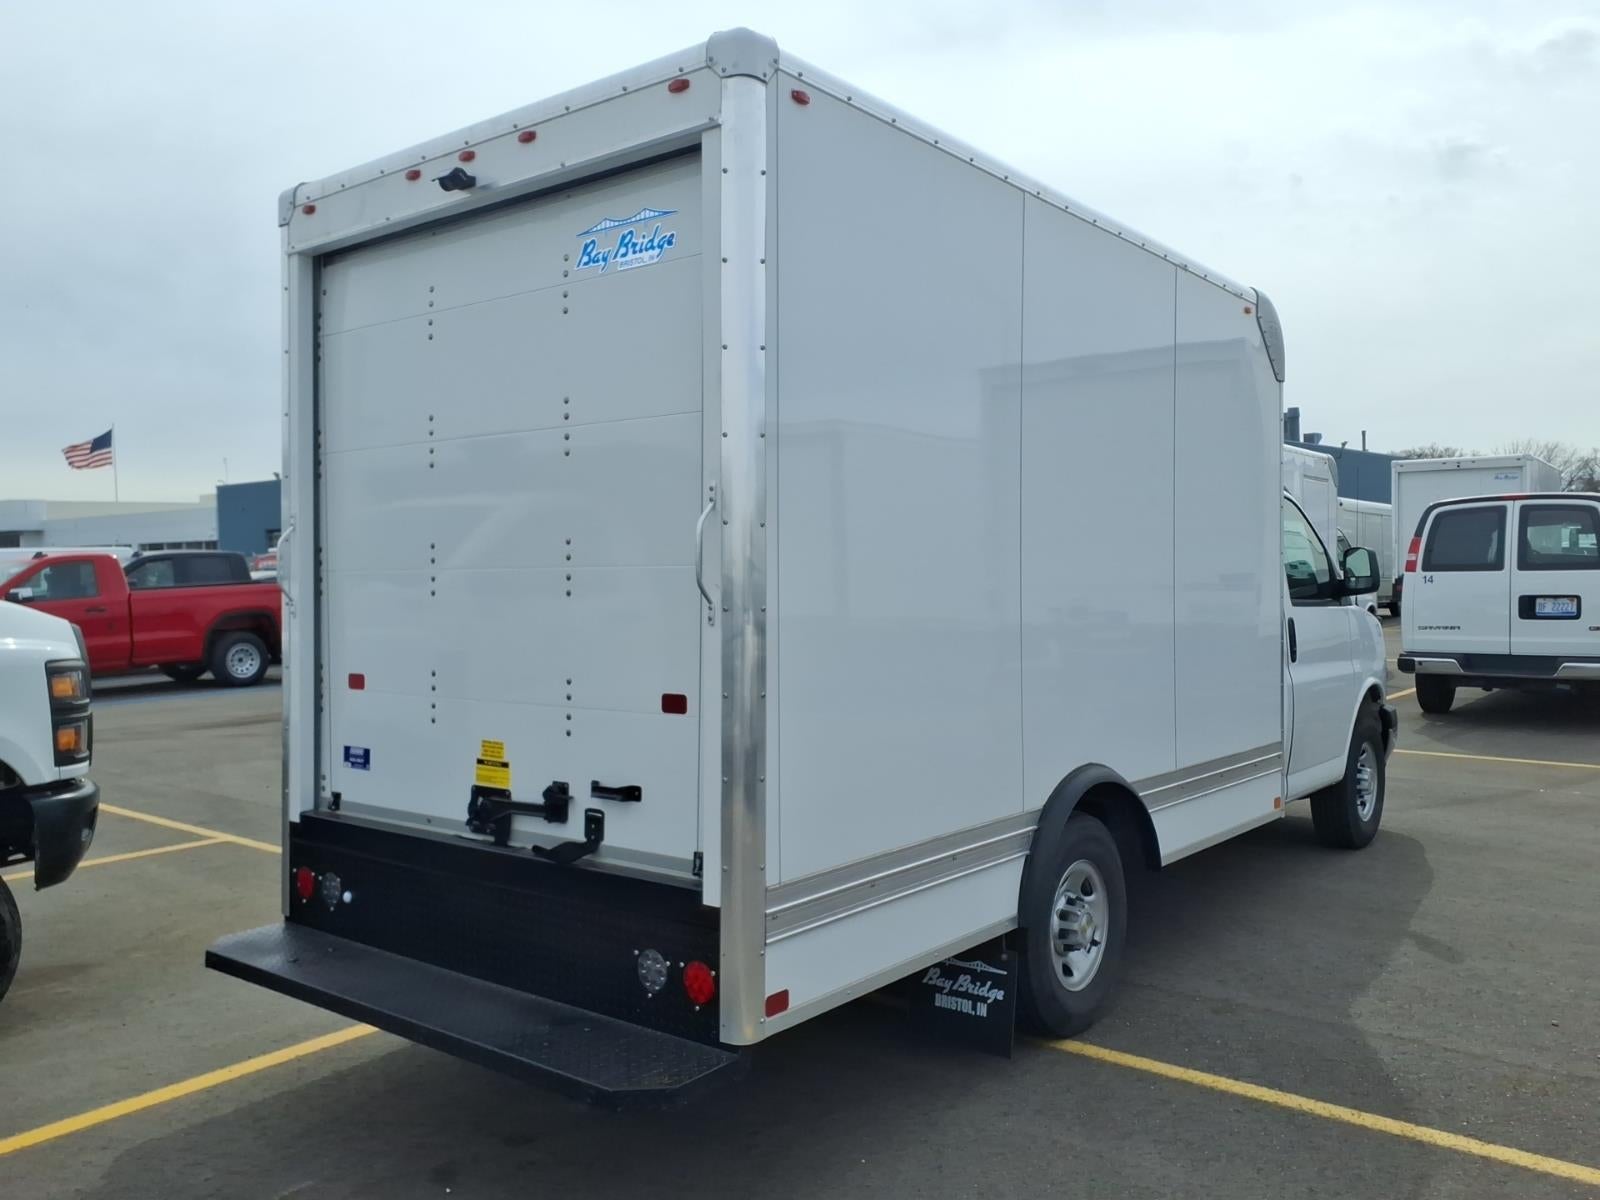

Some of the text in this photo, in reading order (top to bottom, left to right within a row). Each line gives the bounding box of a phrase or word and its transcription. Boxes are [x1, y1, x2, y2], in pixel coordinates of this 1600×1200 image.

[577, 223, 675, 272] Bay Bridge
[1423, 575, 1434, 584] 14
[922, 967, 1005, 1004] Bay Bridge
[934, 993, 988, 1018] BRISTOL, IN
